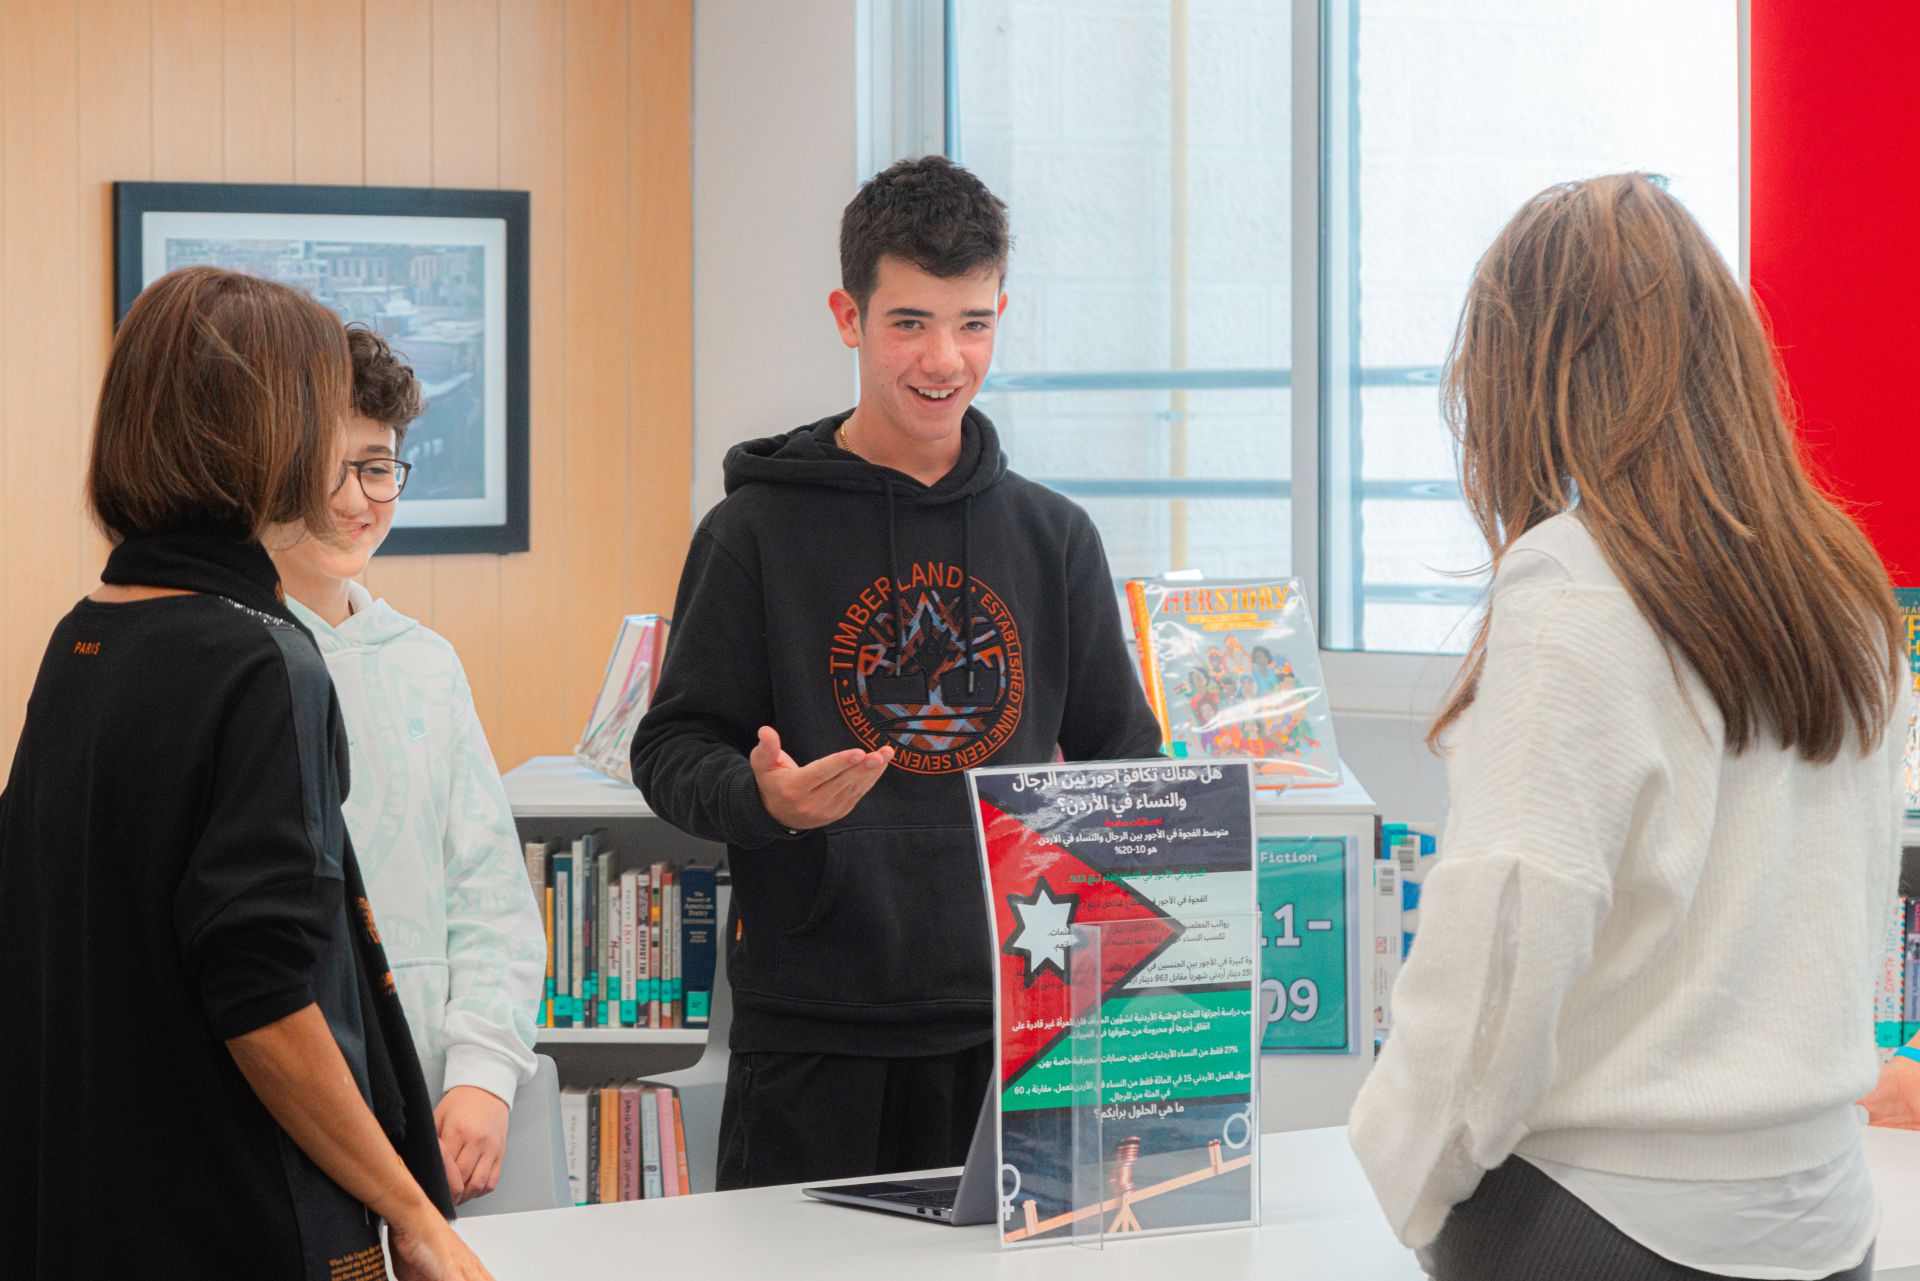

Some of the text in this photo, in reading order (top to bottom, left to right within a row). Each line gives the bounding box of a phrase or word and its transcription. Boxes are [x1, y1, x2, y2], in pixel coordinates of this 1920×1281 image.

[1163, 586, 1290, 613] HERSTORY
[73, 640, 101, 656] PARIS
[979, 592, 1022, 703] ESTABLISHED
[843, 692, 881, 747] THREE
[955, 708, 1019, 766] NINETEEN
[1162, 766, 1197, 781] هناك
[1200, 765, 1222, 784] هل
[1012, 771, 1058, 792] الرجال
[1061, 773, 1086, 790] بين
[1111, 793, 1133, 817] في
[1136, 792, 1187, 811] والنساء
[1075, 832, 1104, 843] والنساء
[1105, 831, 1128, 843] الرجال
[1129, 832, 1143, 842] بين
[1144, 828, 1165, 841] الأجور
[1166, 829, 1177, 843] في
[1178, 829, 1201, 840] الفجوة
[1202, 828, 1229, 838] متوسط
[1062, 832, 1074, 847] في
[1147, 847, 1157, 855] هو
[1260, 852, 1318, 863] Fiction
[1177, 896, 1187, 906] في
[1158, 960, 1186, 971] الجنسين
[1218, 959, 1227, 968] في
[1228, 956, 1244, 966] كبيرة
[1147, 963, 1157, 972] في
[1138, 975, 1154, 985] دينار
[1155, 974, 1168, 982] 963
[1169, 973, 1188, 983] مقابل
[1209, 969, 1225, 981] أردني
[1226, 970, 1241, 980] دينار
[1883, 956, 1896, 993] ALWAYS
[1158, 1011, 1181, 1021] الوطنية
[1182, 1009, 1201, 1019] اللجنة
[1221, 1007, 1240, 1017] دراسة
[1012, 1021, 1025, 1032] على
[1026, 1018, 1043, 1031] قادرة
[1043, 1018, 1055, 1030] غير
[1168, 1022, 1174, 1035] أو
[1131, 1029, 1142, 1037] من
[1143, 1025, 1168, 1036] محرومة
[1148, 1048, 1177, 1061] الأردنيات
[1177, 1048, 1198, 1058] النساء
[1198, 1049, 1208, 1058] من
[1209, 1045, 1224, 1056] فقط
[1053, 1056, 1071, 1066] خاصة
[1139, 1076, 1153, 1086] فقط
[1172, 1073, 1182, 1087] في
[1183, 1073, 1192, 1083] 15
[1192, 1071, 1215, 1086] الأردني
[1215, 1071, 1234, 1082] العمل
[1106, 1079, 1127, 1089] النساء
[1128, 1080, 1138, 1089] من
[1014, 1086, 1025, 1095] 60
[1160, 1088, 1171, 1102] في
[1132, 1092, 1143, 1101] من
[1128, 1103, 1157, 1120] الحلول
[1158, 1104, 1174, 1120] هي
[1174, 1102, 1185, 1113] ما
